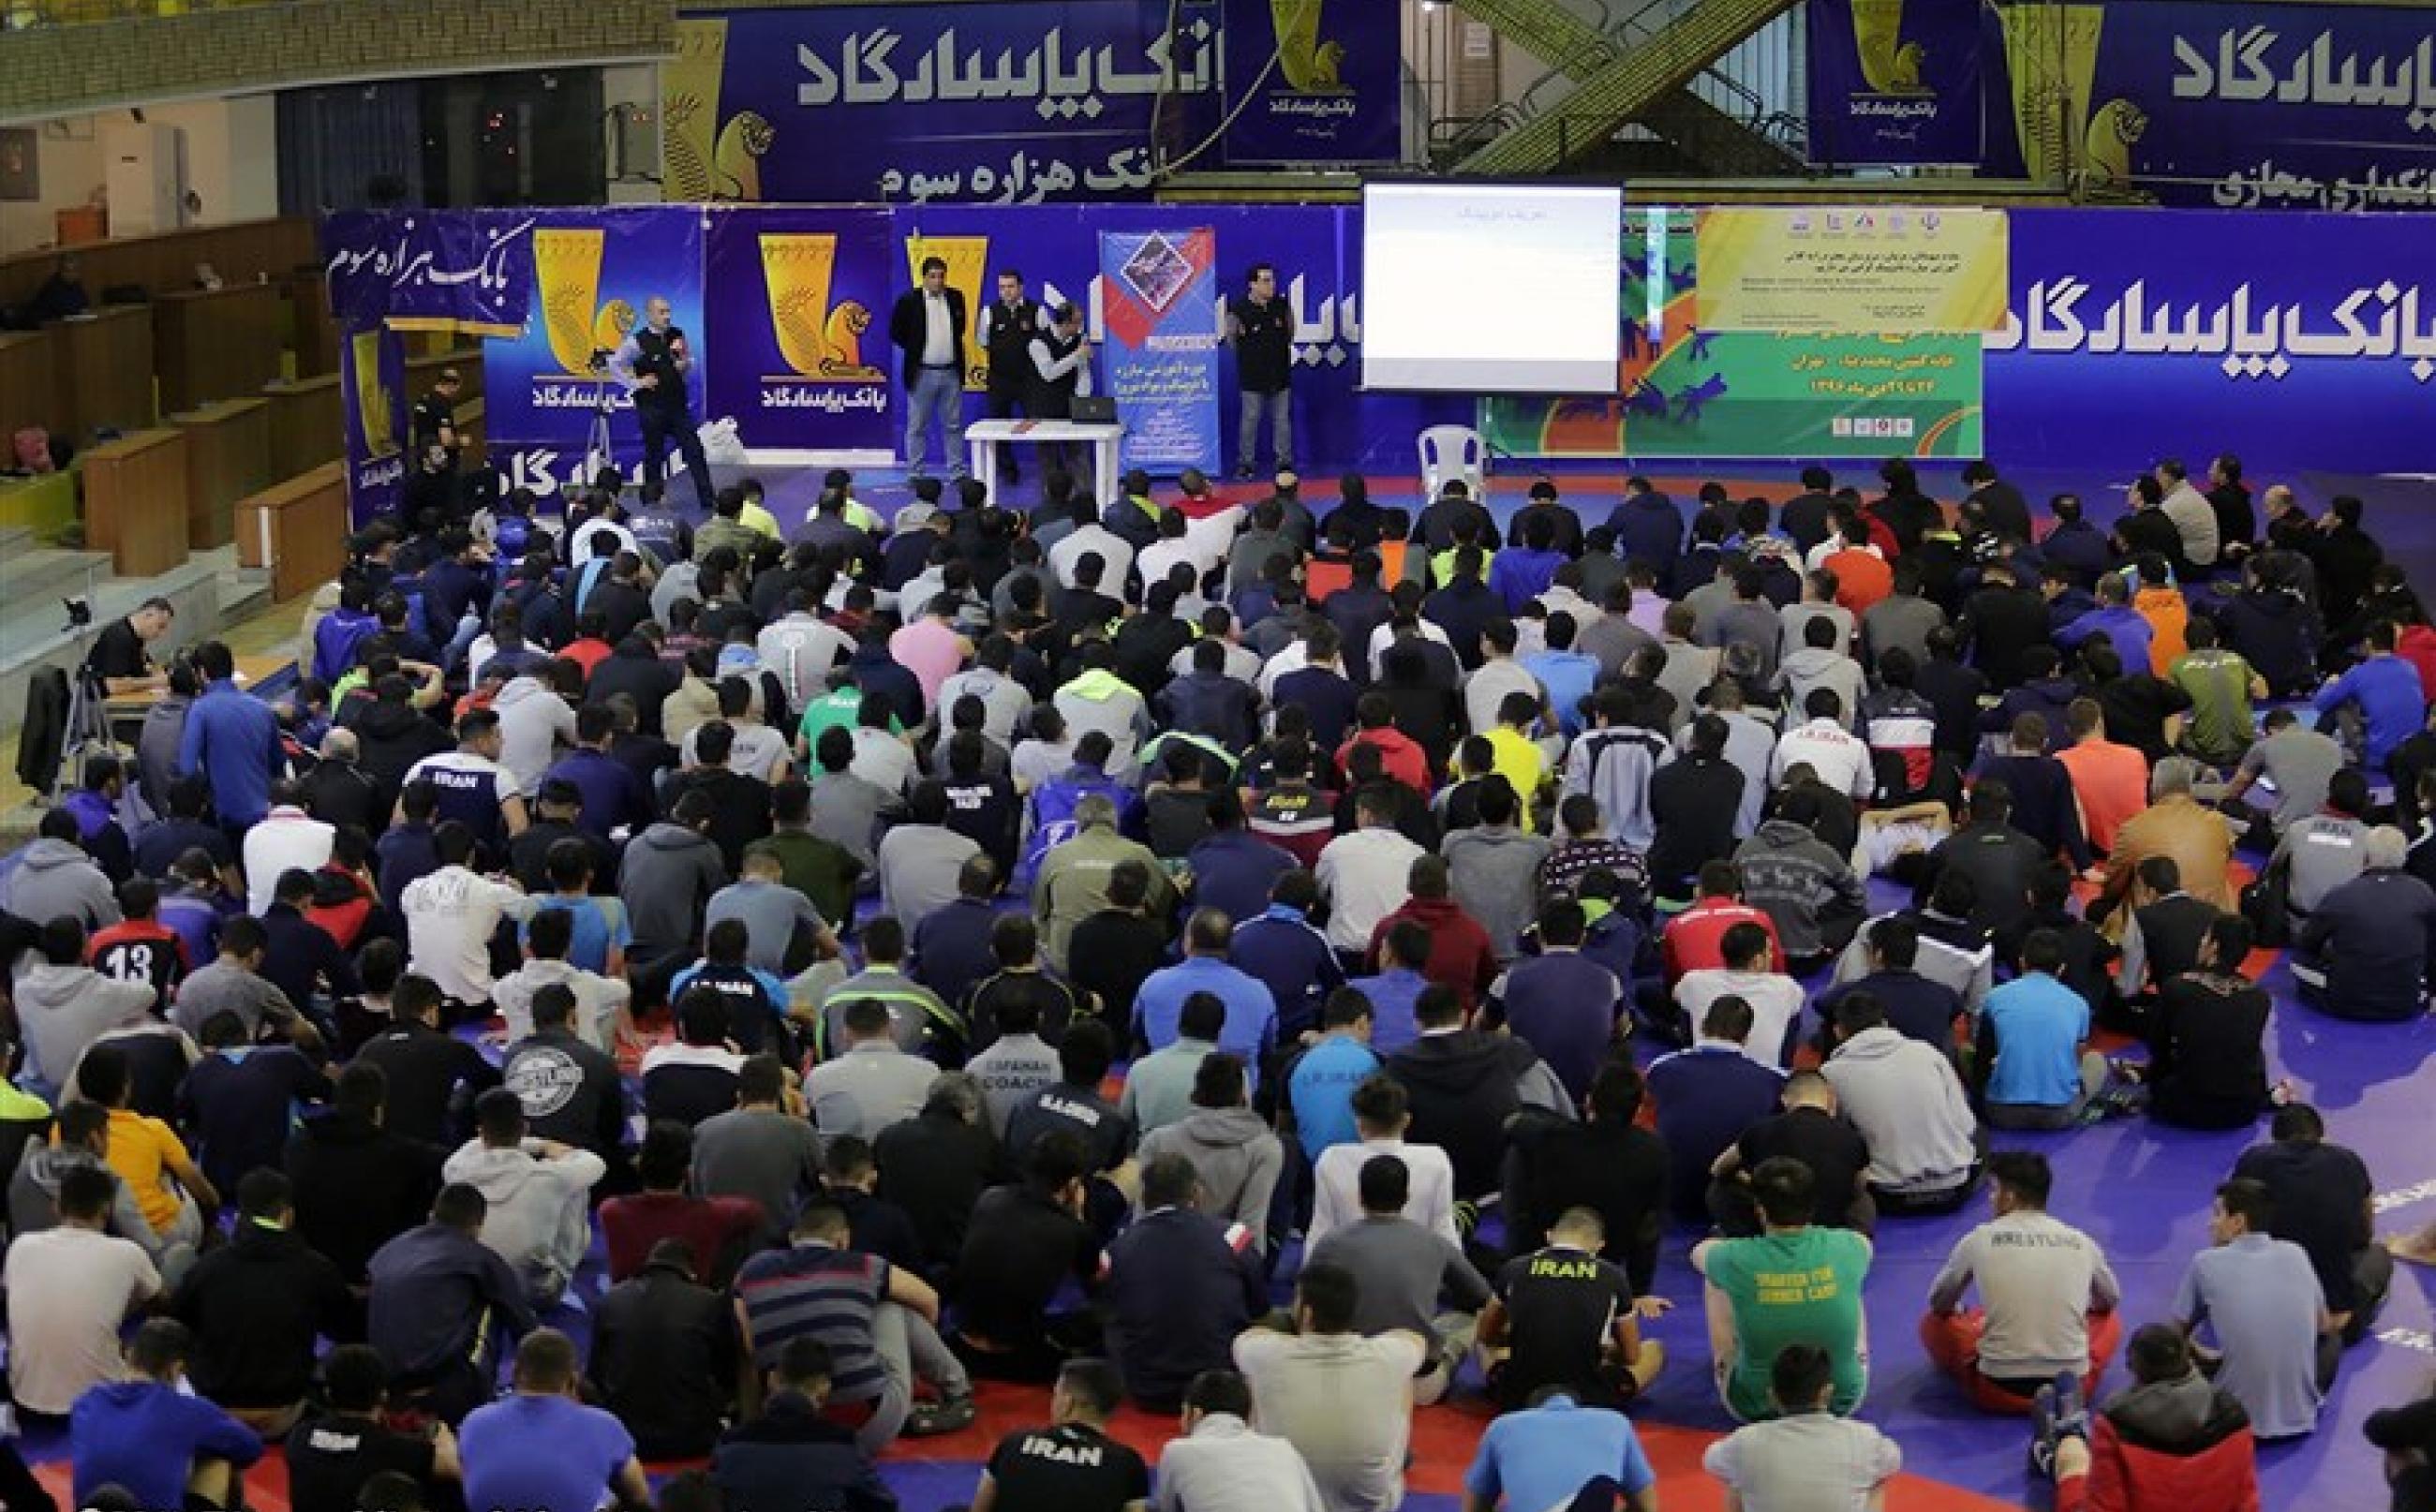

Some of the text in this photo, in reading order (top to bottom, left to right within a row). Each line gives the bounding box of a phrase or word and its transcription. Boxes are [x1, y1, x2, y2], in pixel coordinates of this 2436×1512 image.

[797, 26, 1103, 120] پاسارگاد
[971, 150, 1077, 204] هزاره
[326, 216, 537, 311] بانک هزاره سوم
[761, 386, 887, 413] بانک پاسارگاد
[434, 770, 479, 789] IRAN
[106, 944, 153, 980] 13
[1529, 1258, 1597, 1280] IRAN
[1021, 1434, 1104, 1472] IRAN
